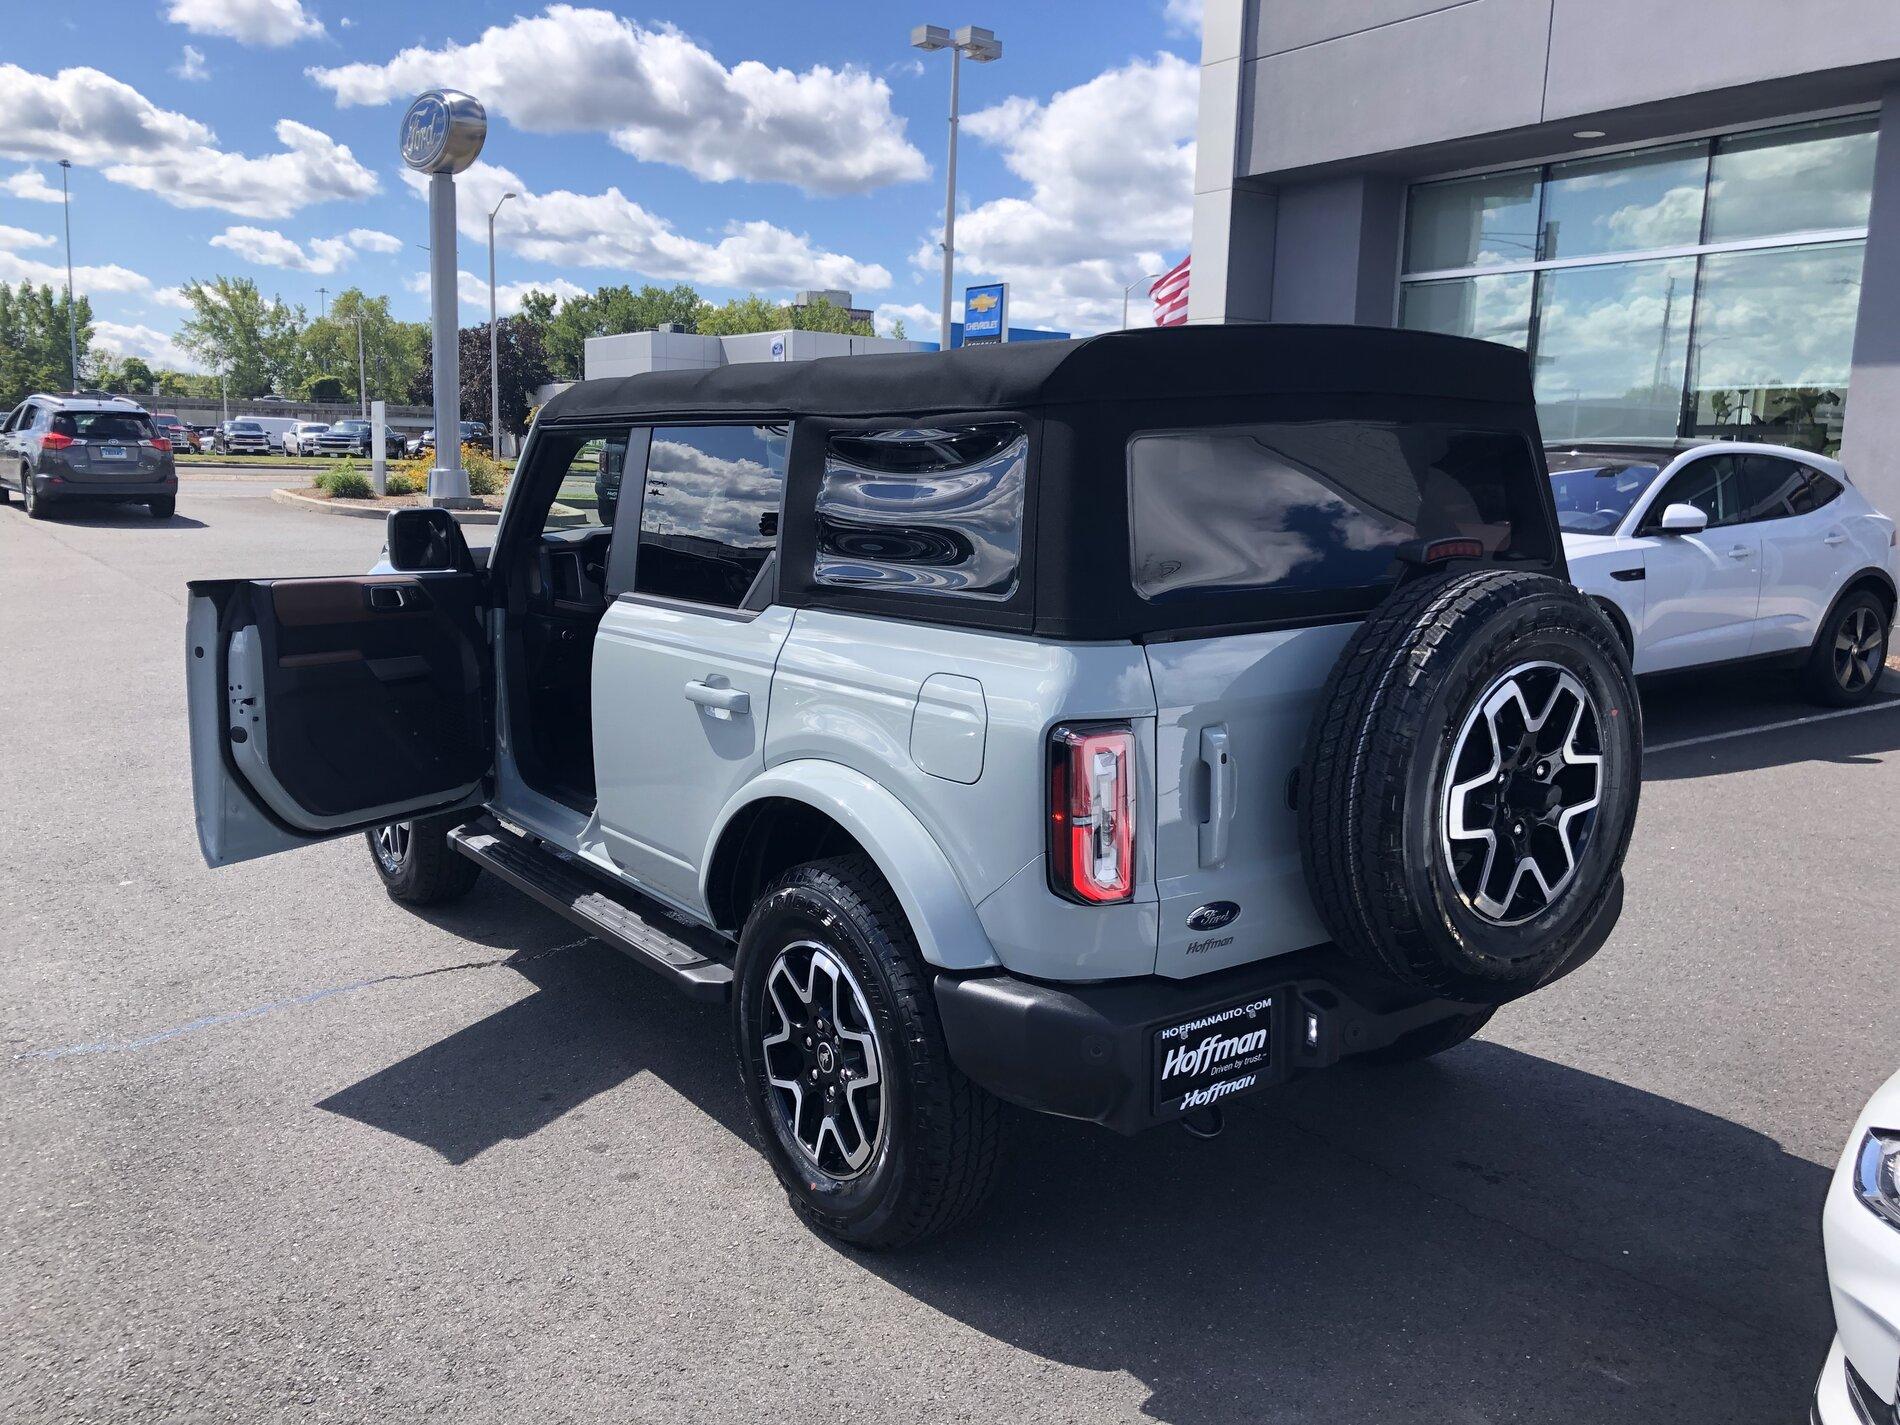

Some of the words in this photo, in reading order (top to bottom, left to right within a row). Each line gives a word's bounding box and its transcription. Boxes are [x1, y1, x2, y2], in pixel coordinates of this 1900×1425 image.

[406, 106, 437, 153] Ford
[965, 320, 999, 332] CHEVROLET
[1200, 909, 1230, 925] Ford
[1185, 936, 1234, 955] Hoffman
[1162, 998, 1272, 1040] HOFFMANAUTO.COM
[1161, 1028, 1267, 1081] Hoffman
[1210, 1063, 1233, 1076] Driven
[1234, 1059, 1243, 1069] by
[1180, 1074, 1257, 1111] Hoffman
